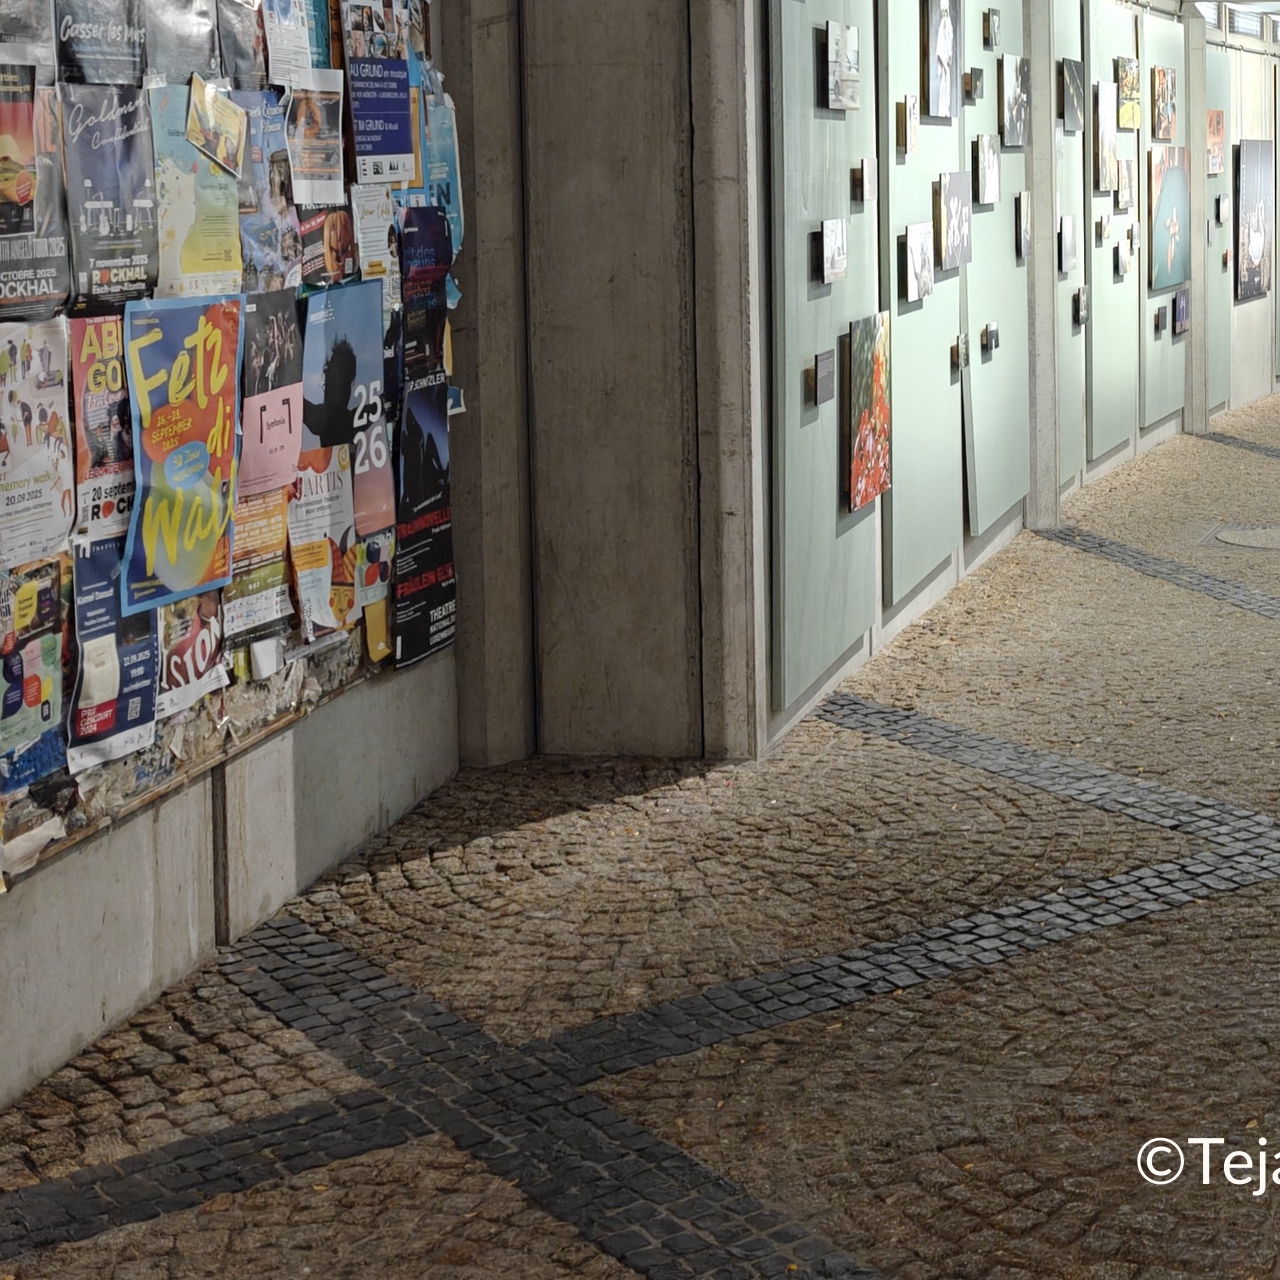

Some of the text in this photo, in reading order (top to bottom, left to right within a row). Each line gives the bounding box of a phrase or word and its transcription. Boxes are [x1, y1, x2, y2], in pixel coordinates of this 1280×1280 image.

[128, 315, 228, 429] Fetz
[206, 396, 231, 458] di
[353, 380, 382, 428] 25
[353, 425, 387, 475] 26
[92, 486, 102, 502] 20
